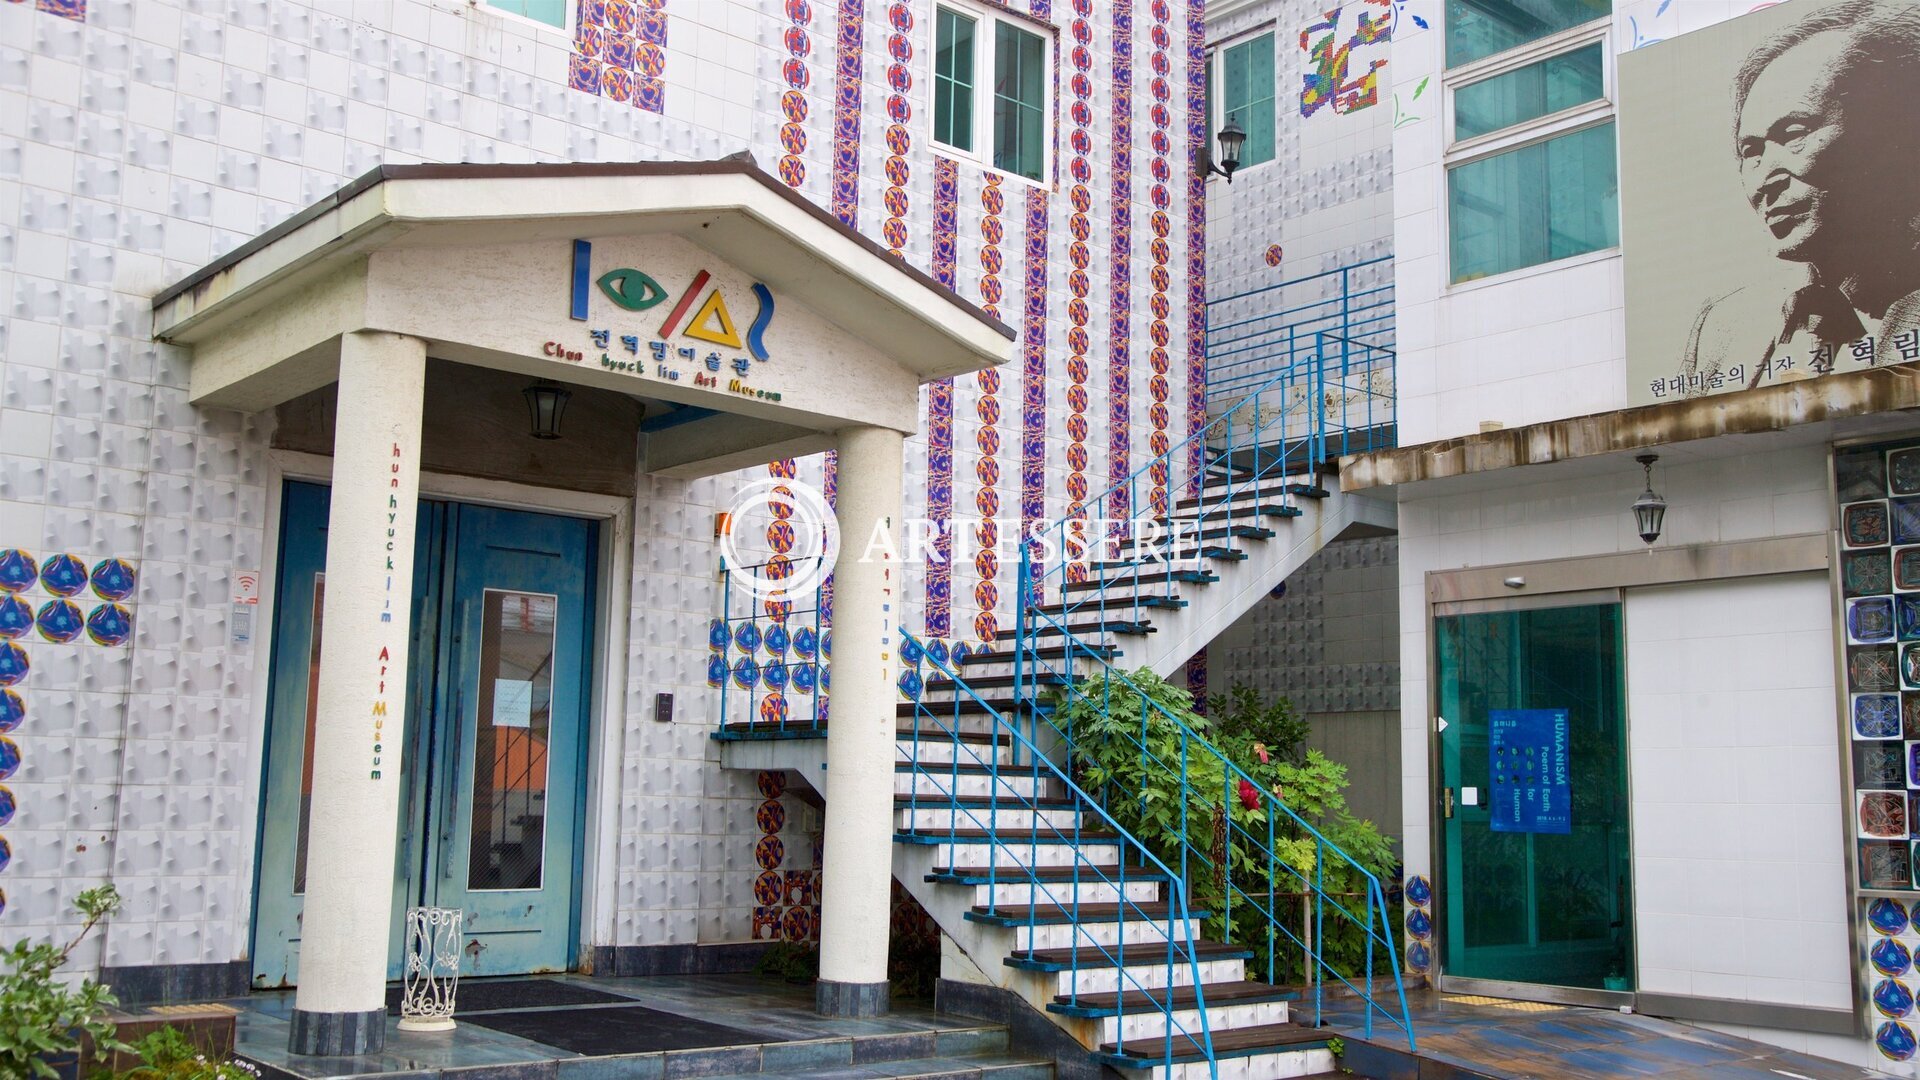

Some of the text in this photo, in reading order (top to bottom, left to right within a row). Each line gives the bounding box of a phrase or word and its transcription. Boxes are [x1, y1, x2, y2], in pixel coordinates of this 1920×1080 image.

[543, 341, 782, 402] Chun hyuck lim Art Museum
[1649, 364, 1746, 398] 현대미술의
[378, 645, 389, 695] Art
[370, 700, 388, 781] Museum
[1554, 713, 1566, 785] HUMANISM
[1513, 788, 1521, 822] Human
[1527, 788, 1536, 801] for
[1541, 746, 1551, 812] Poem of Earth
